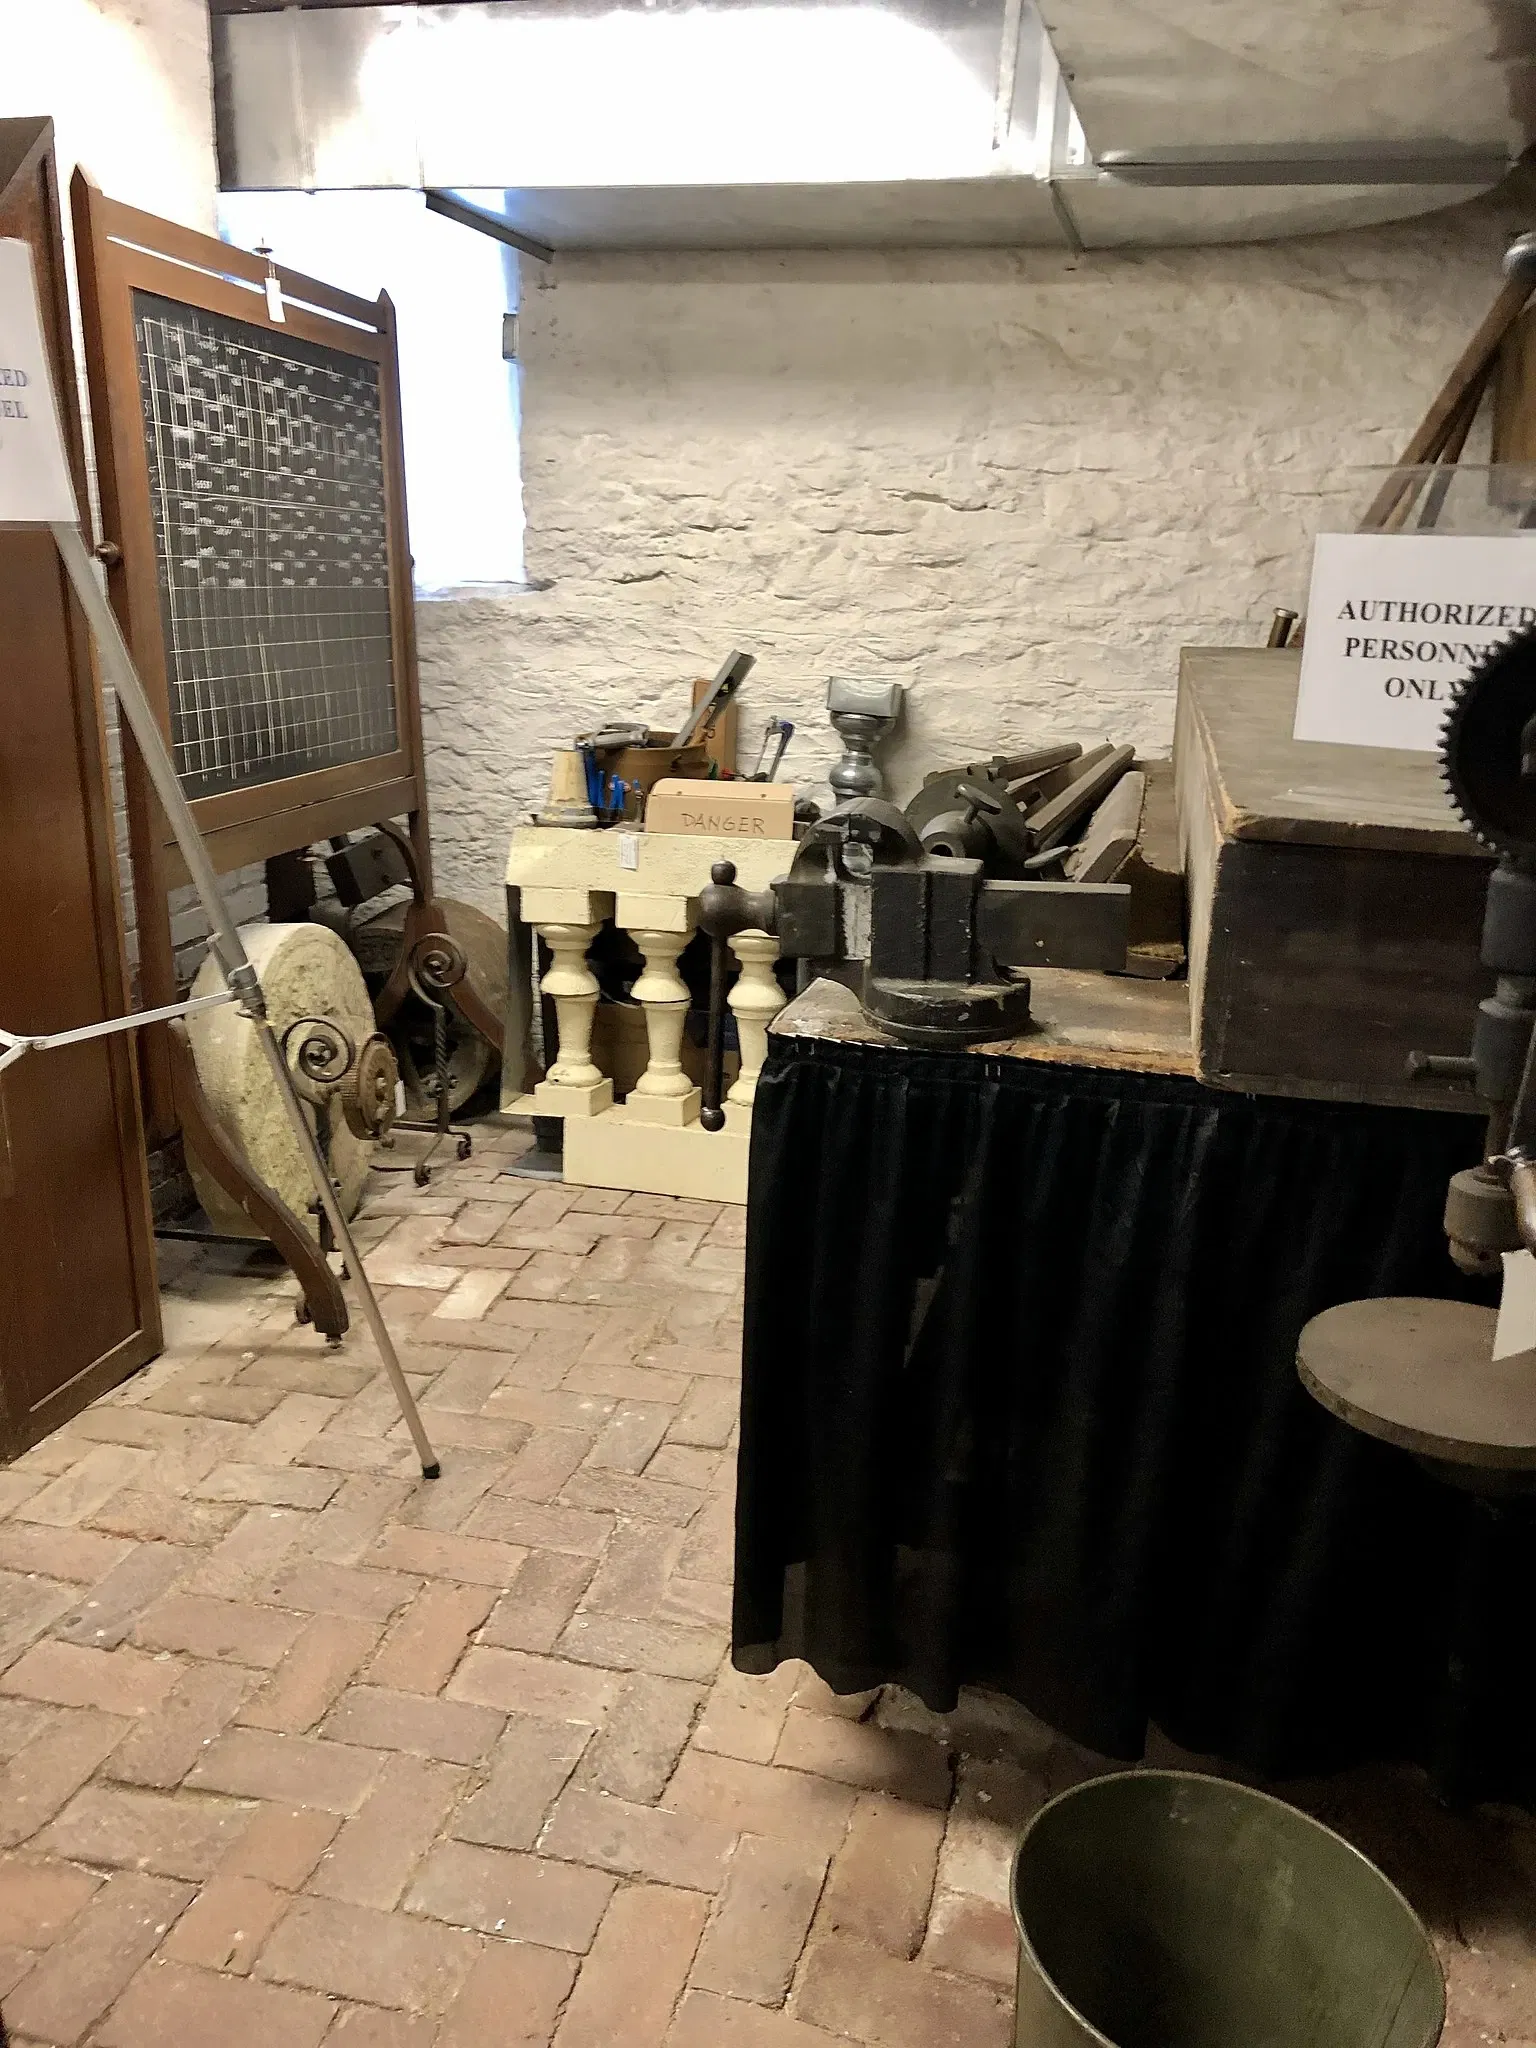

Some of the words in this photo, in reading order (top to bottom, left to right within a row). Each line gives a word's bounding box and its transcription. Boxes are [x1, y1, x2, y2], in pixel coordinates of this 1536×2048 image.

[0, 368, 27, 387] ED
[0, 400, 28, 419] EL
[1337, 600, 1536, 627] AUTHORIZED
[681, 813, 765, 834] DANGER
